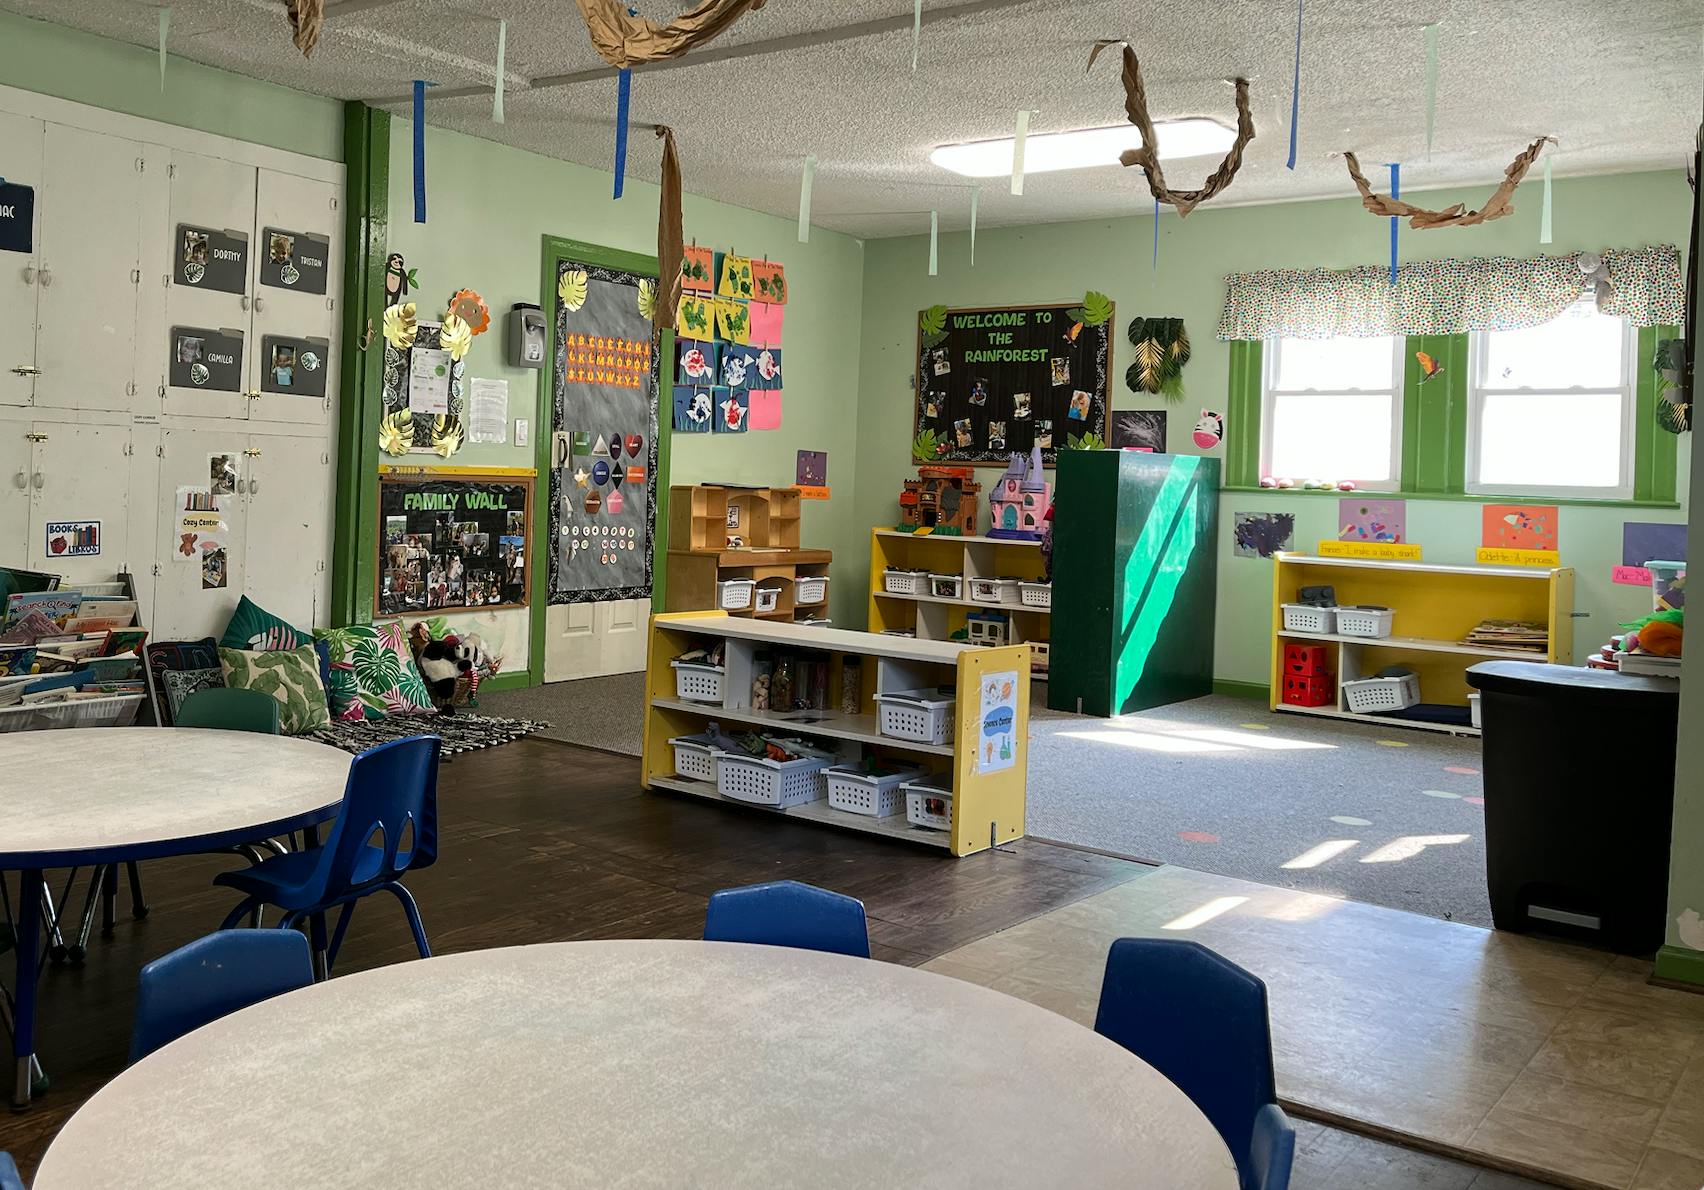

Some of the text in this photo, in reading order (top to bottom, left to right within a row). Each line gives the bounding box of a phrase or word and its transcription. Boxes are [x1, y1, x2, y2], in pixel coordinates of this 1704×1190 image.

[953, 312, 1052, 328] WELCOME TO
[988, 332, 1013, 345] THE
[208, 353, 233, 364] CAMILLA
[965, 349, 1048, 363] RAINFOREST
[404, 491, 507, 511] FAMILY WALL
[50, 524, 78, 534] BOOKS
[183, 518, 198, 527] Cozy
